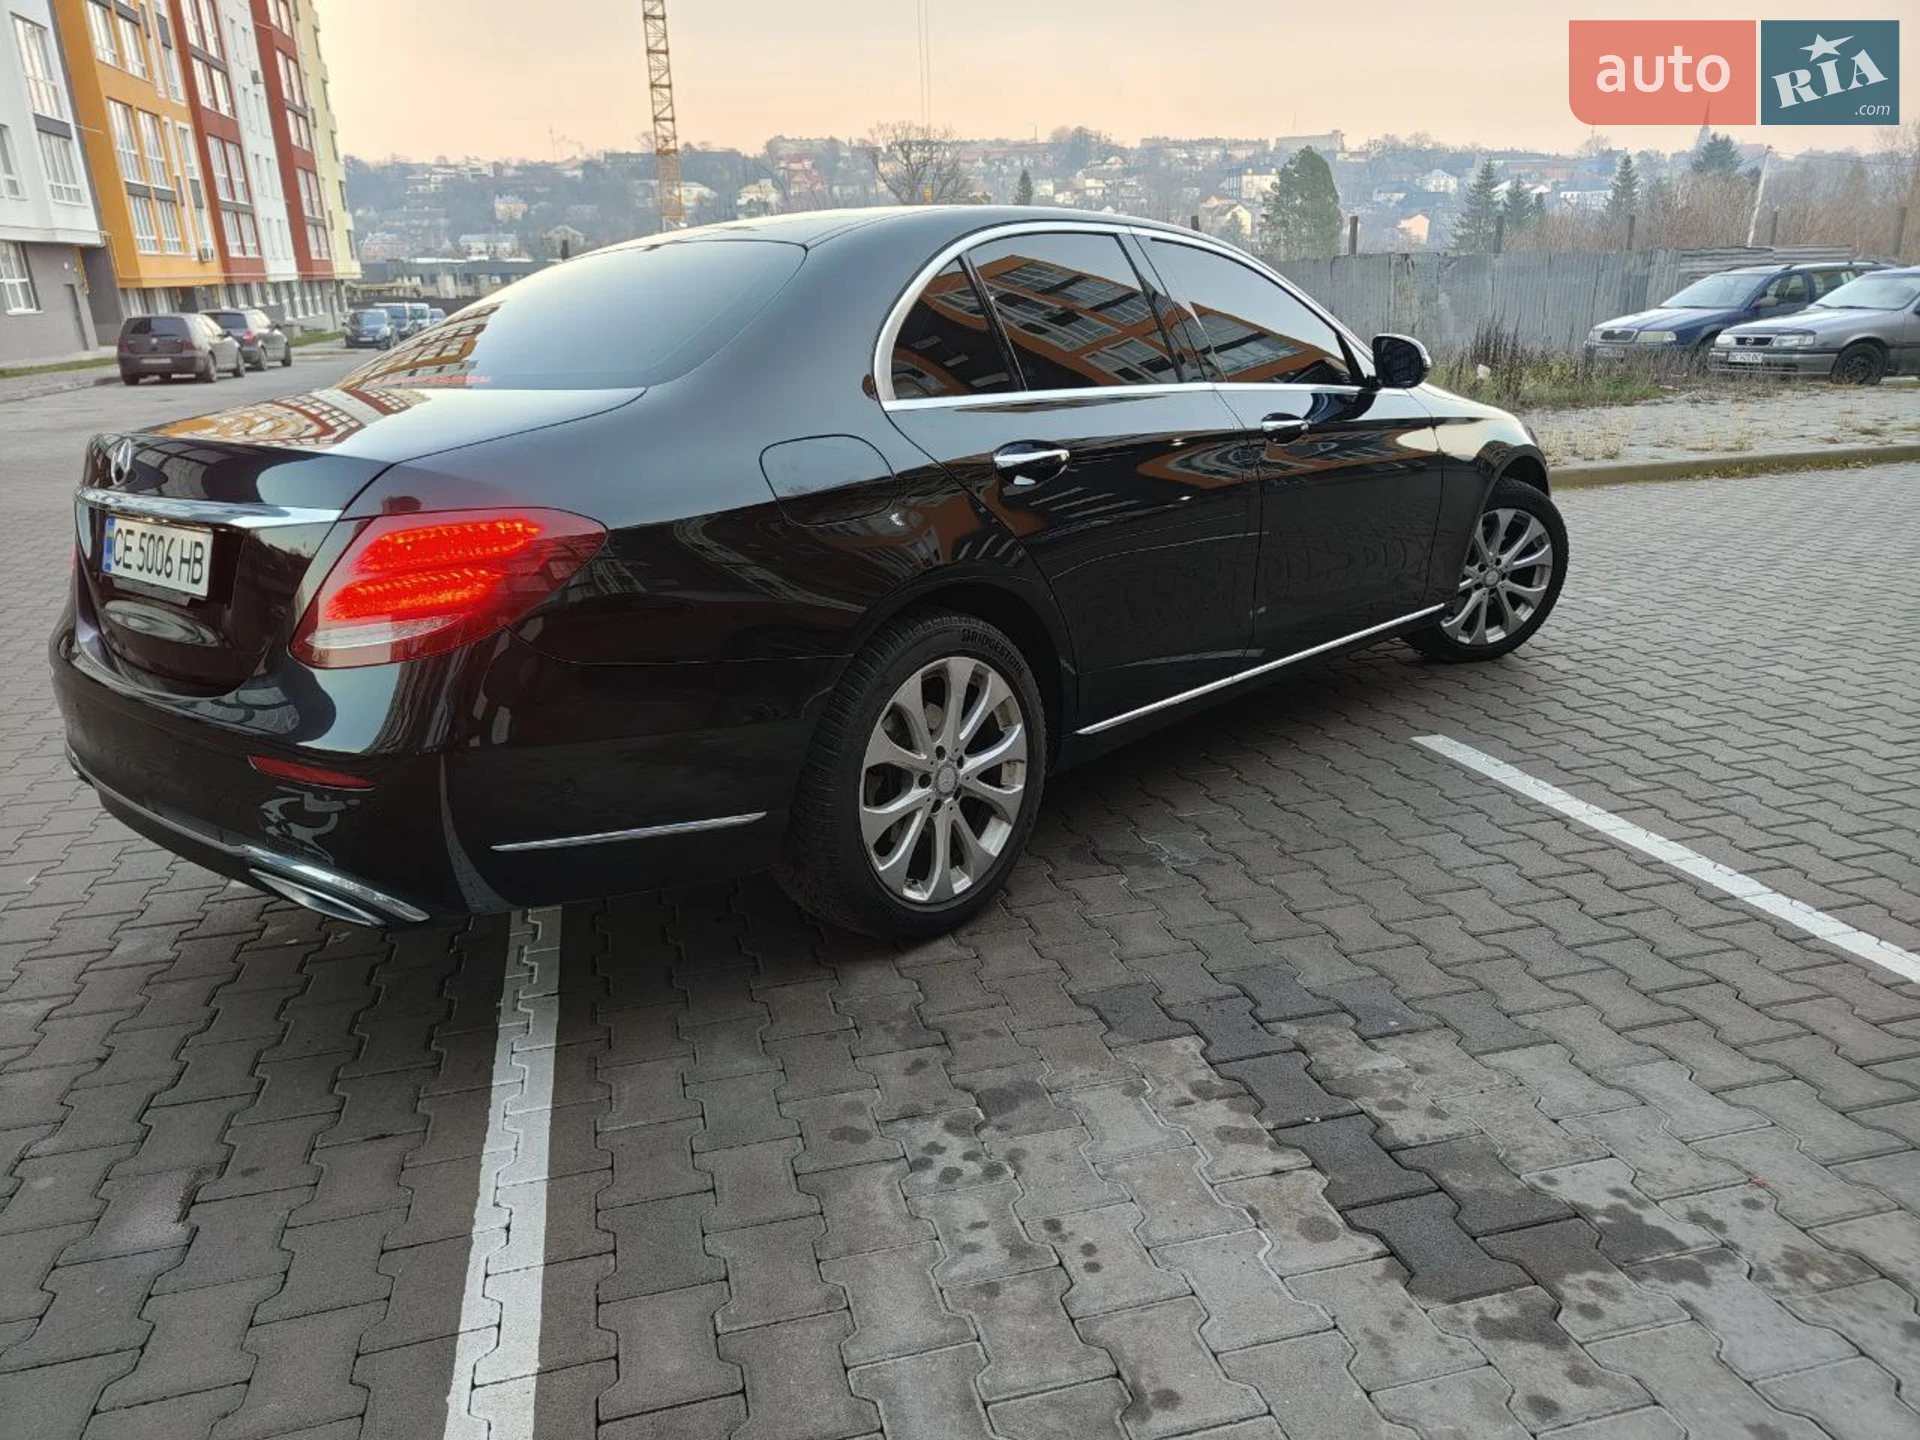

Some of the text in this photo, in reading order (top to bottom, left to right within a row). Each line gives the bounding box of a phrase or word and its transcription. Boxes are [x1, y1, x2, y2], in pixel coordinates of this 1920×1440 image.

[113, 527, 204, 585] CE 5006 HB
